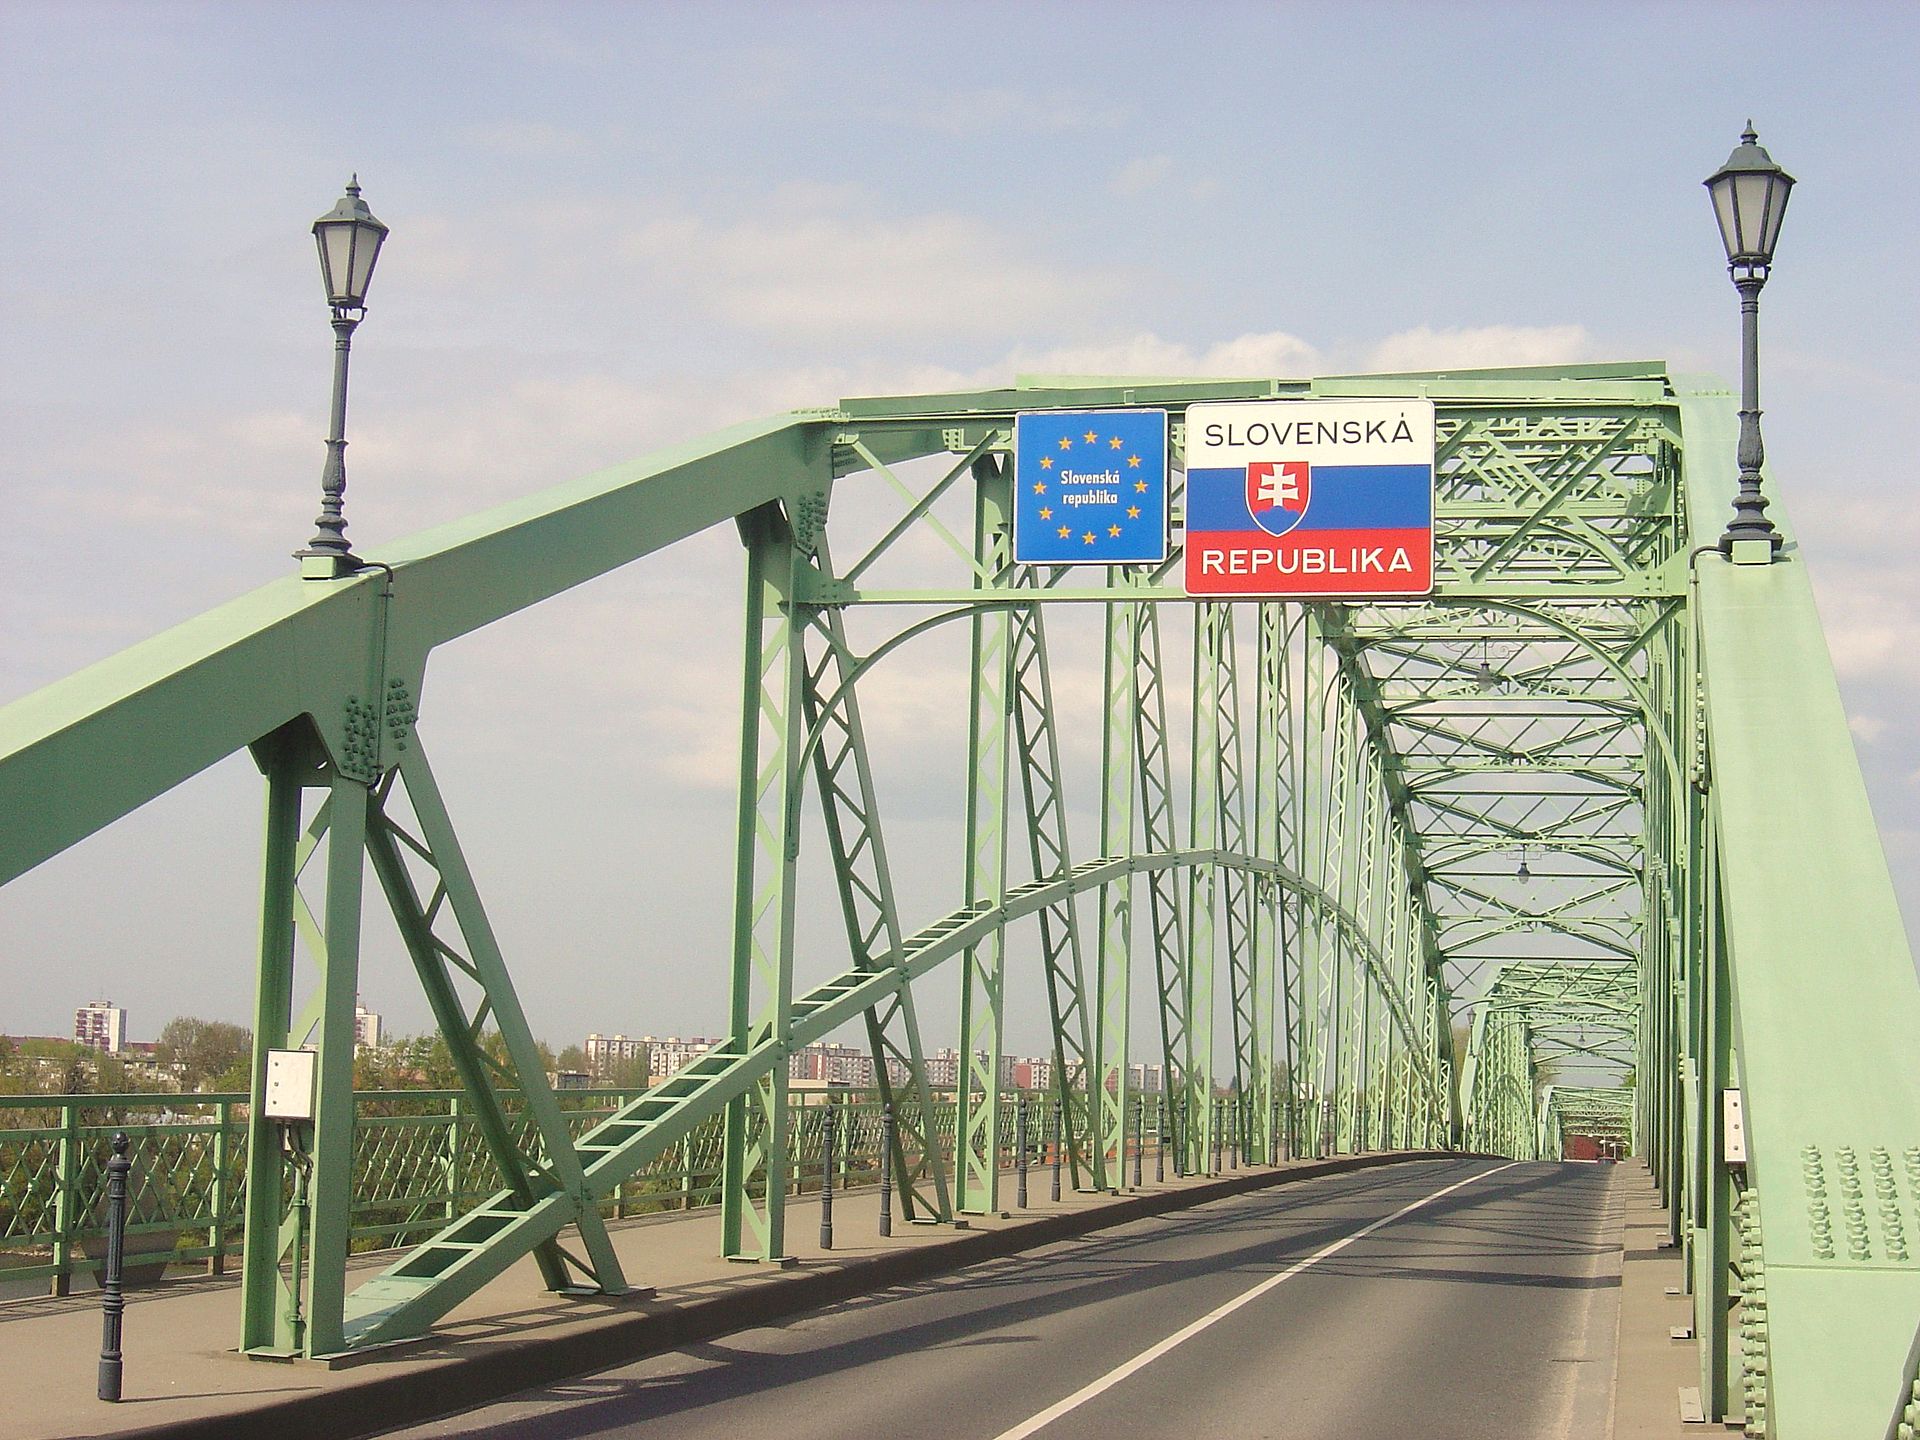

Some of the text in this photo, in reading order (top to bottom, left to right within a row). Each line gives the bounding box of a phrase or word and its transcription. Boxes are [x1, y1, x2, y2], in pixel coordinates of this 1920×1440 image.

[1205, 412, 1414, 447] SLOVENSKÁ
[1060, 469, 1120, 485] Slovenská
[1062, 489, 1118, 508] republika
[1202, 547, 1413, 575] REPUBLIKA
